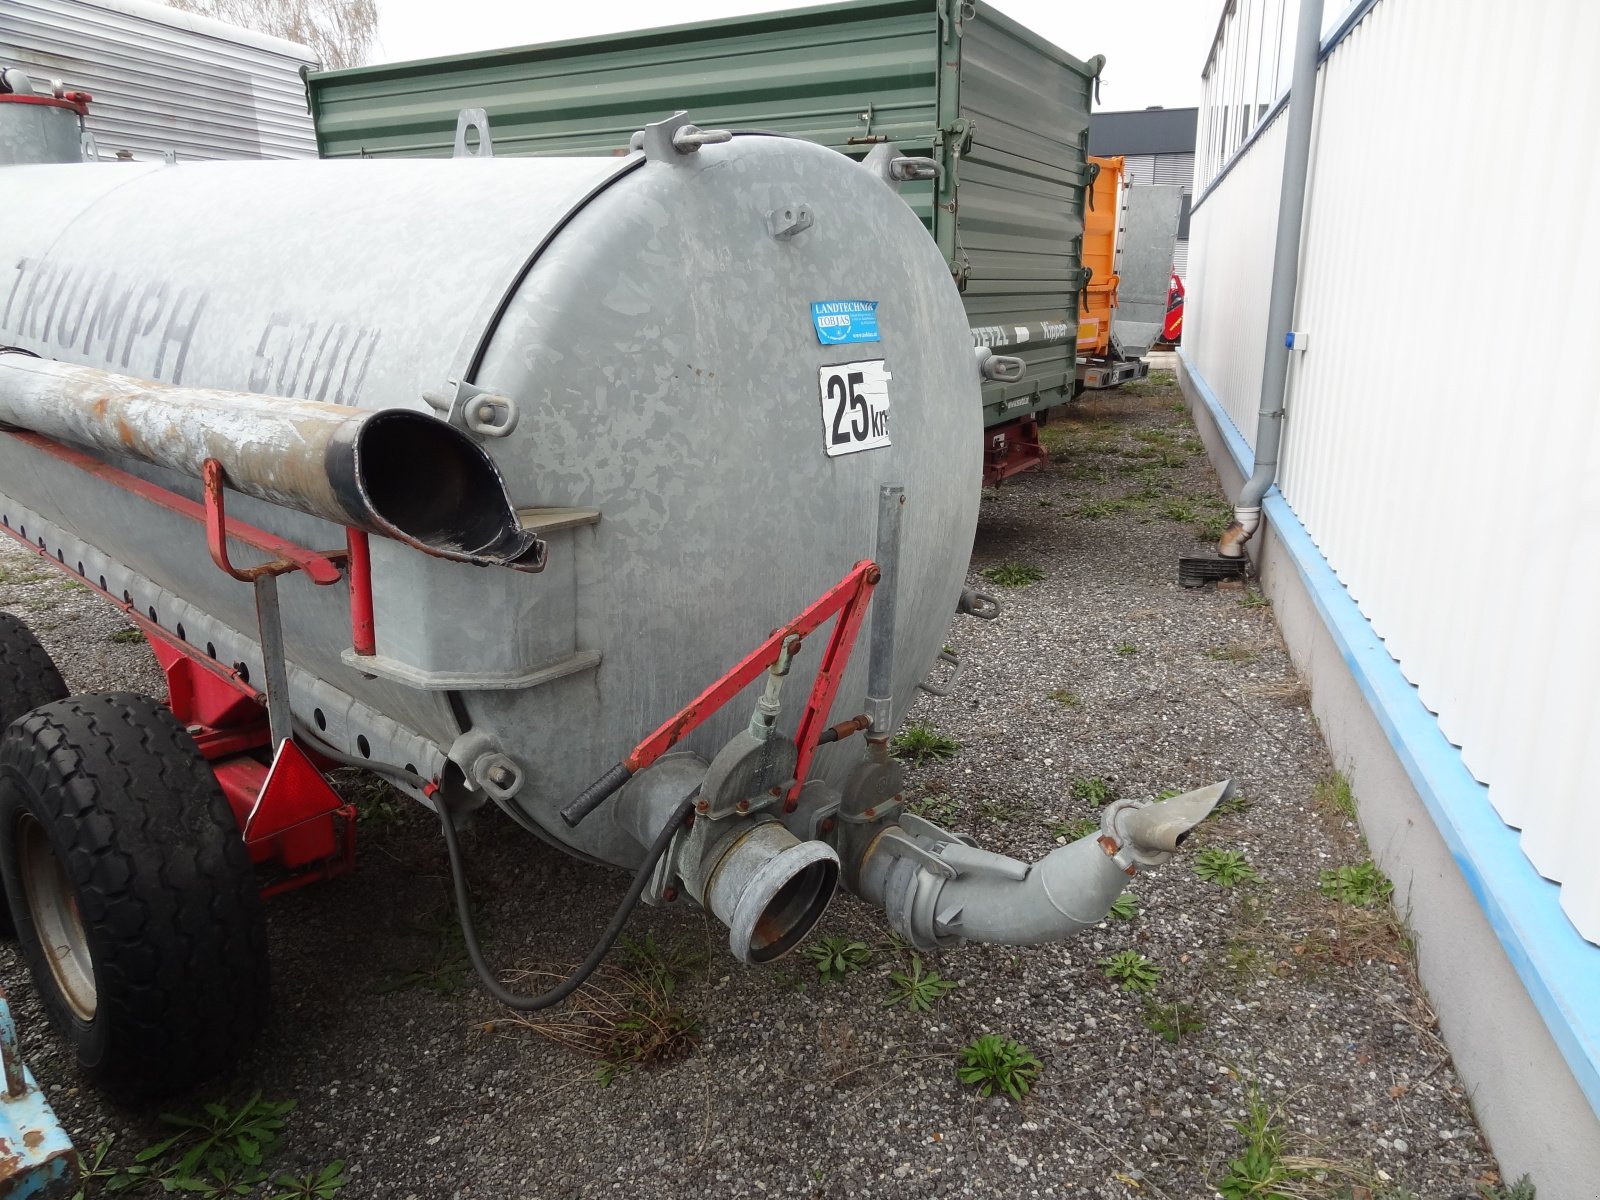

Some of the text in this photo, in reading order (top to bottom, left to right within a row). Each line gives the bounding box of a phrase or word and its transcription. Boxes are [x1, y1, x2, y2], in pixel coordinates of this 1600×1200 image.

[1, 255, 211, 386] TRIUMPH
[815, 302, 874, 314] LANDTECHNIK
[819, 315, 850, 326] TOBIAS
[970, 321, 1067, 348] TETZL Kipper
[827, 371, 870, 445] 25
